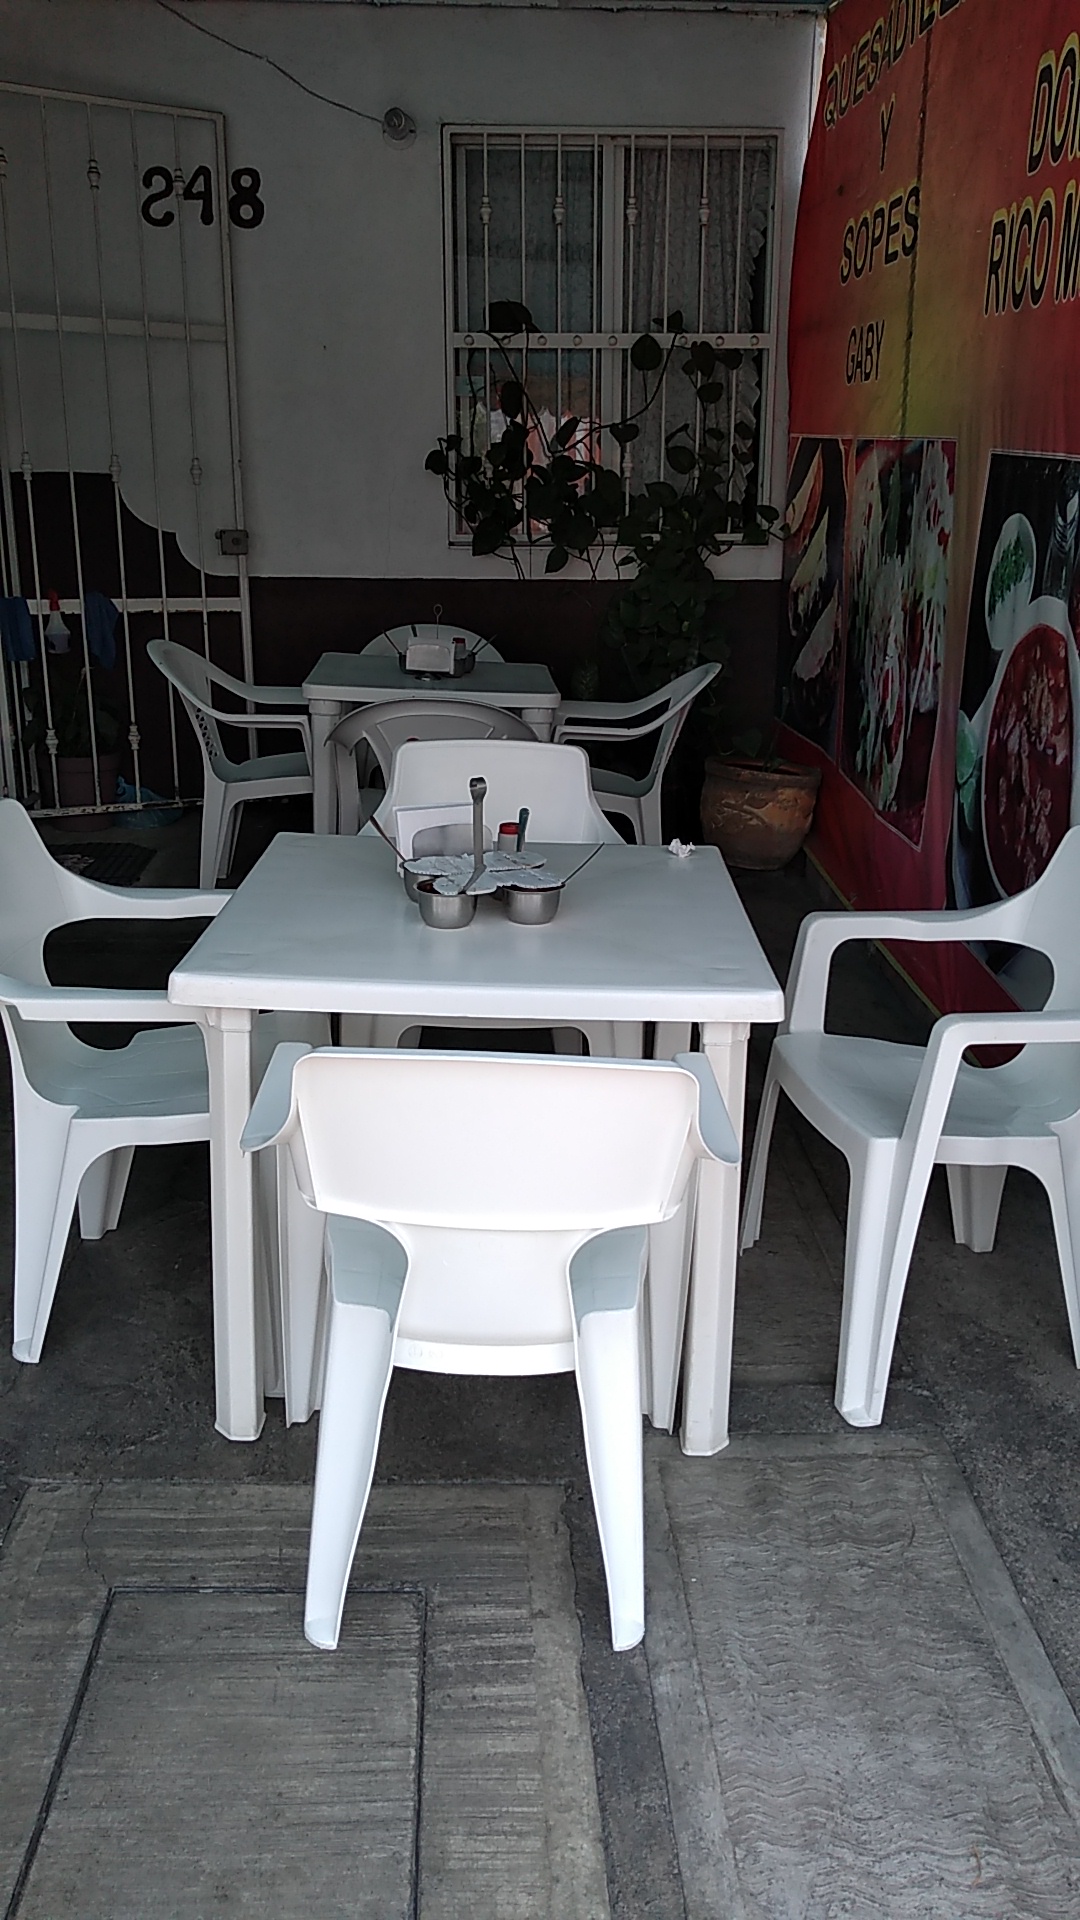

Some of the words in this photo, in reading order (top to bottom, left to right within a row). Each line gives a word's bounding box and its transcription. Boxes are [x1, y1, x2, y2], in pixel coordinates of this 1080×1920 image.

[825, 0, 965, 130] QUESADIL
[879, 92, 896, 172] Y
[141, 165, 265, 229] 248
[841, 180, 921, 286] SOPES
[985, 187, 1055, 317] RICO
[846, 319, 885, 386] GABY
